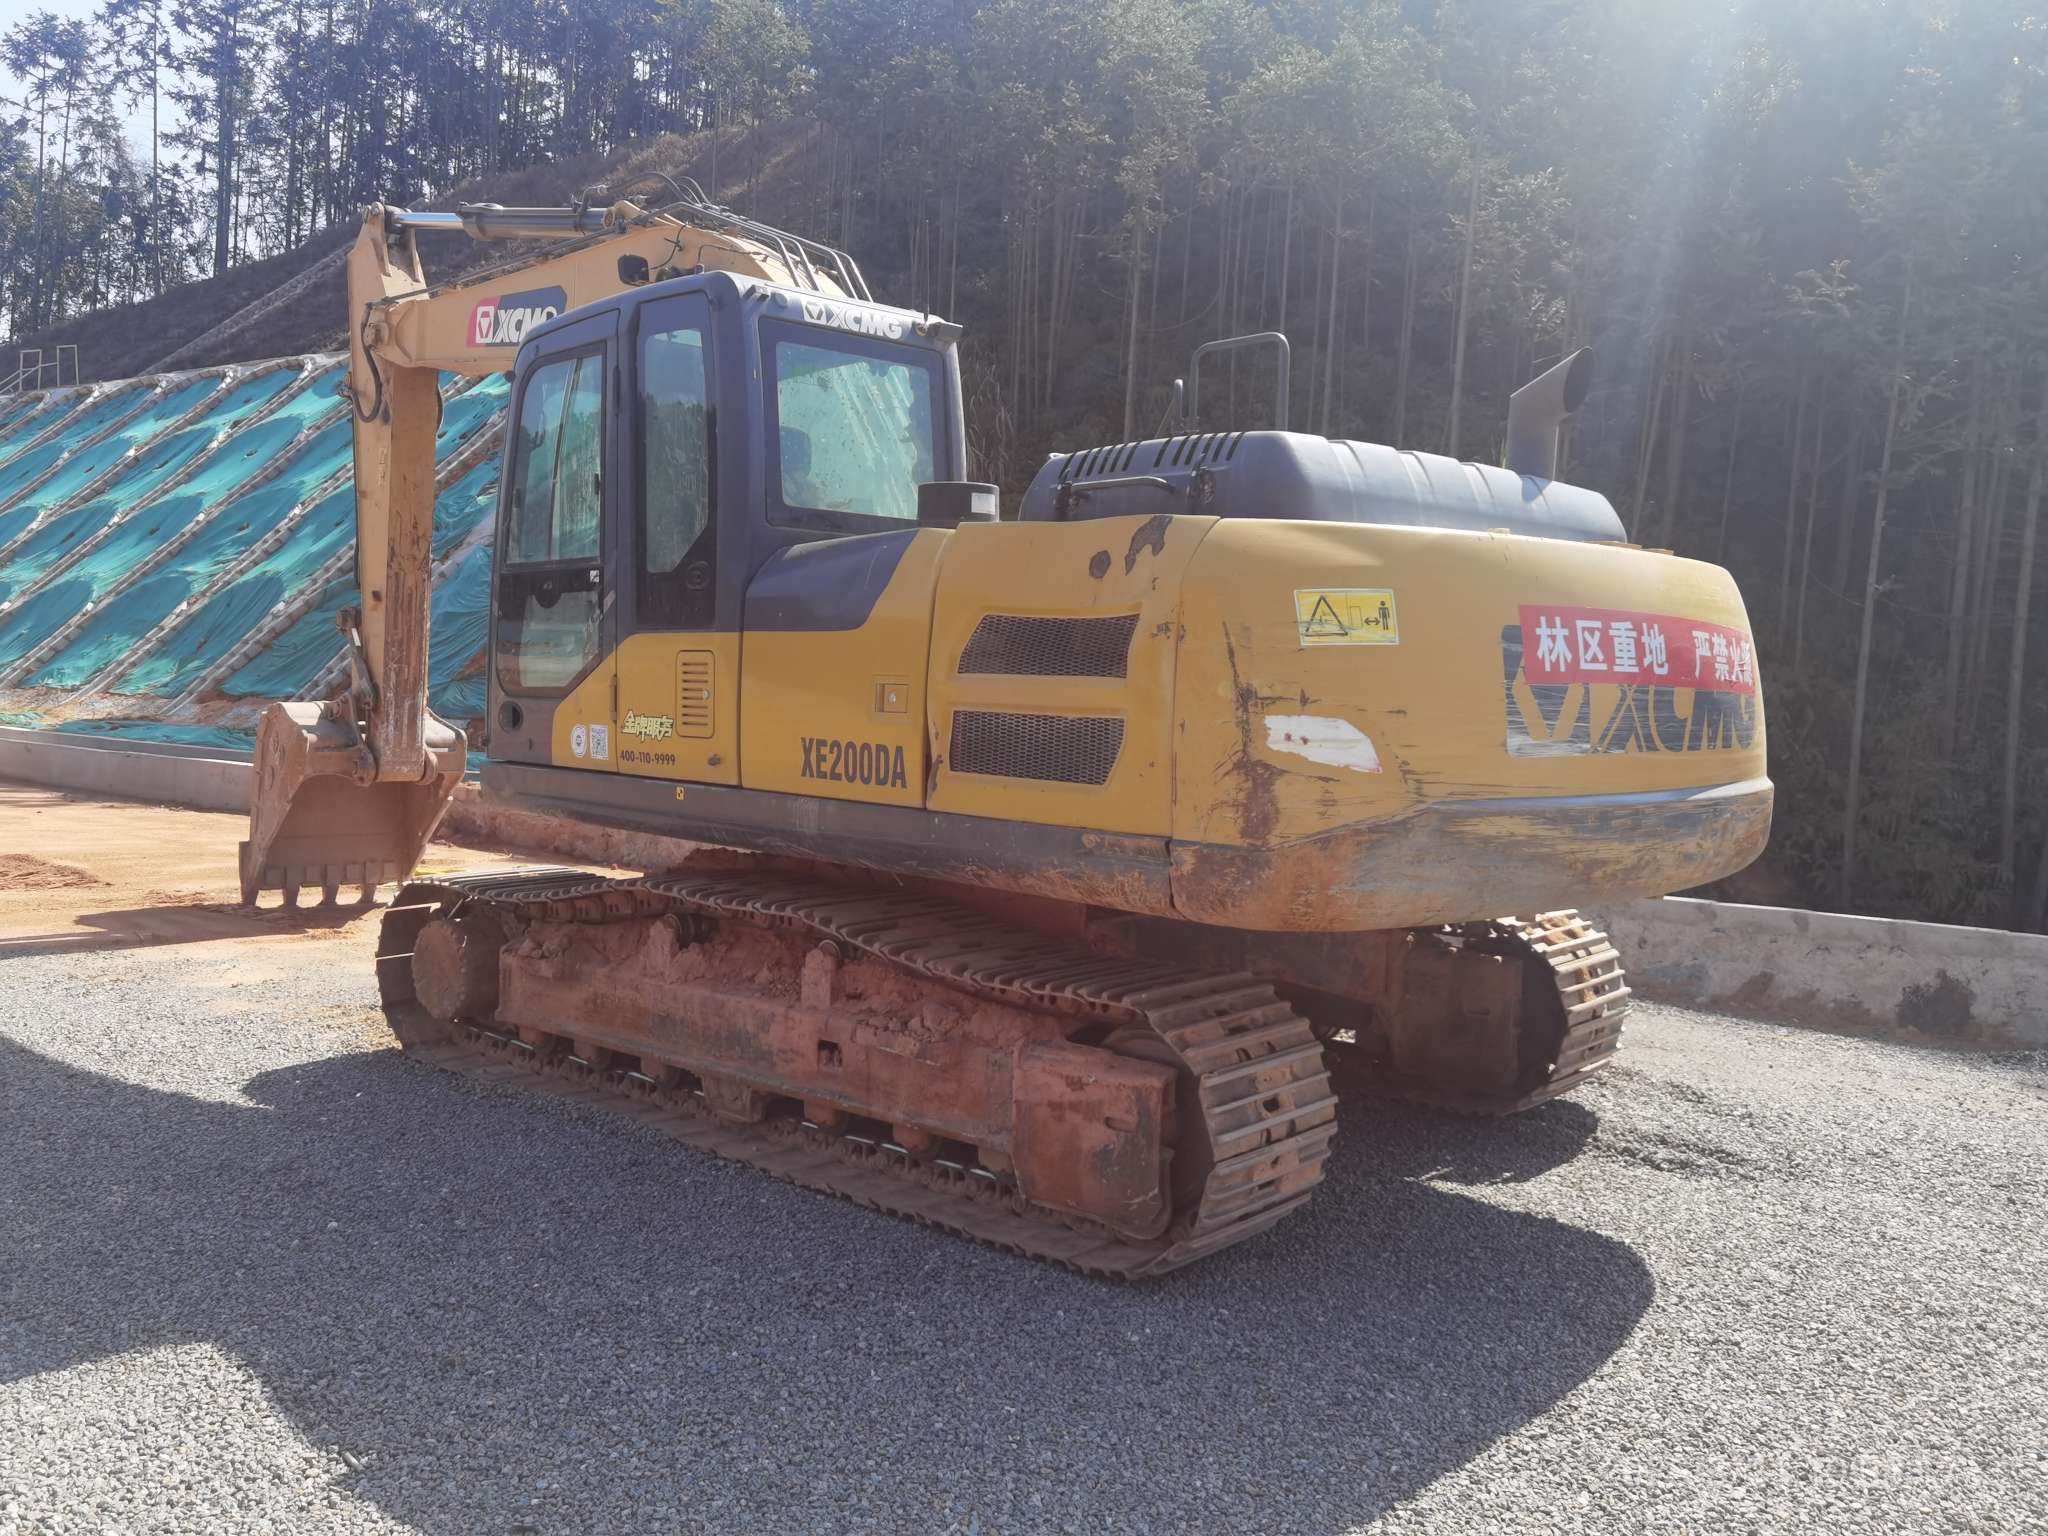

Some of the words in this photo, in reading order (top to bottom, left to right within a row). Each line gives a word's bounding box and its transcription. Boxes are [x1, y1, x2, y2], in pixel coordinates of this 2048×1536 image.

[825, 303, 903, 340] XCMG
[1535, 615, 1669, 675] 林区重地
[621, 710, 674, 742] 金牌服务
[620, 750, 676, 766] 400-110-9999
[800, 736, 908, 789] XE200DA
